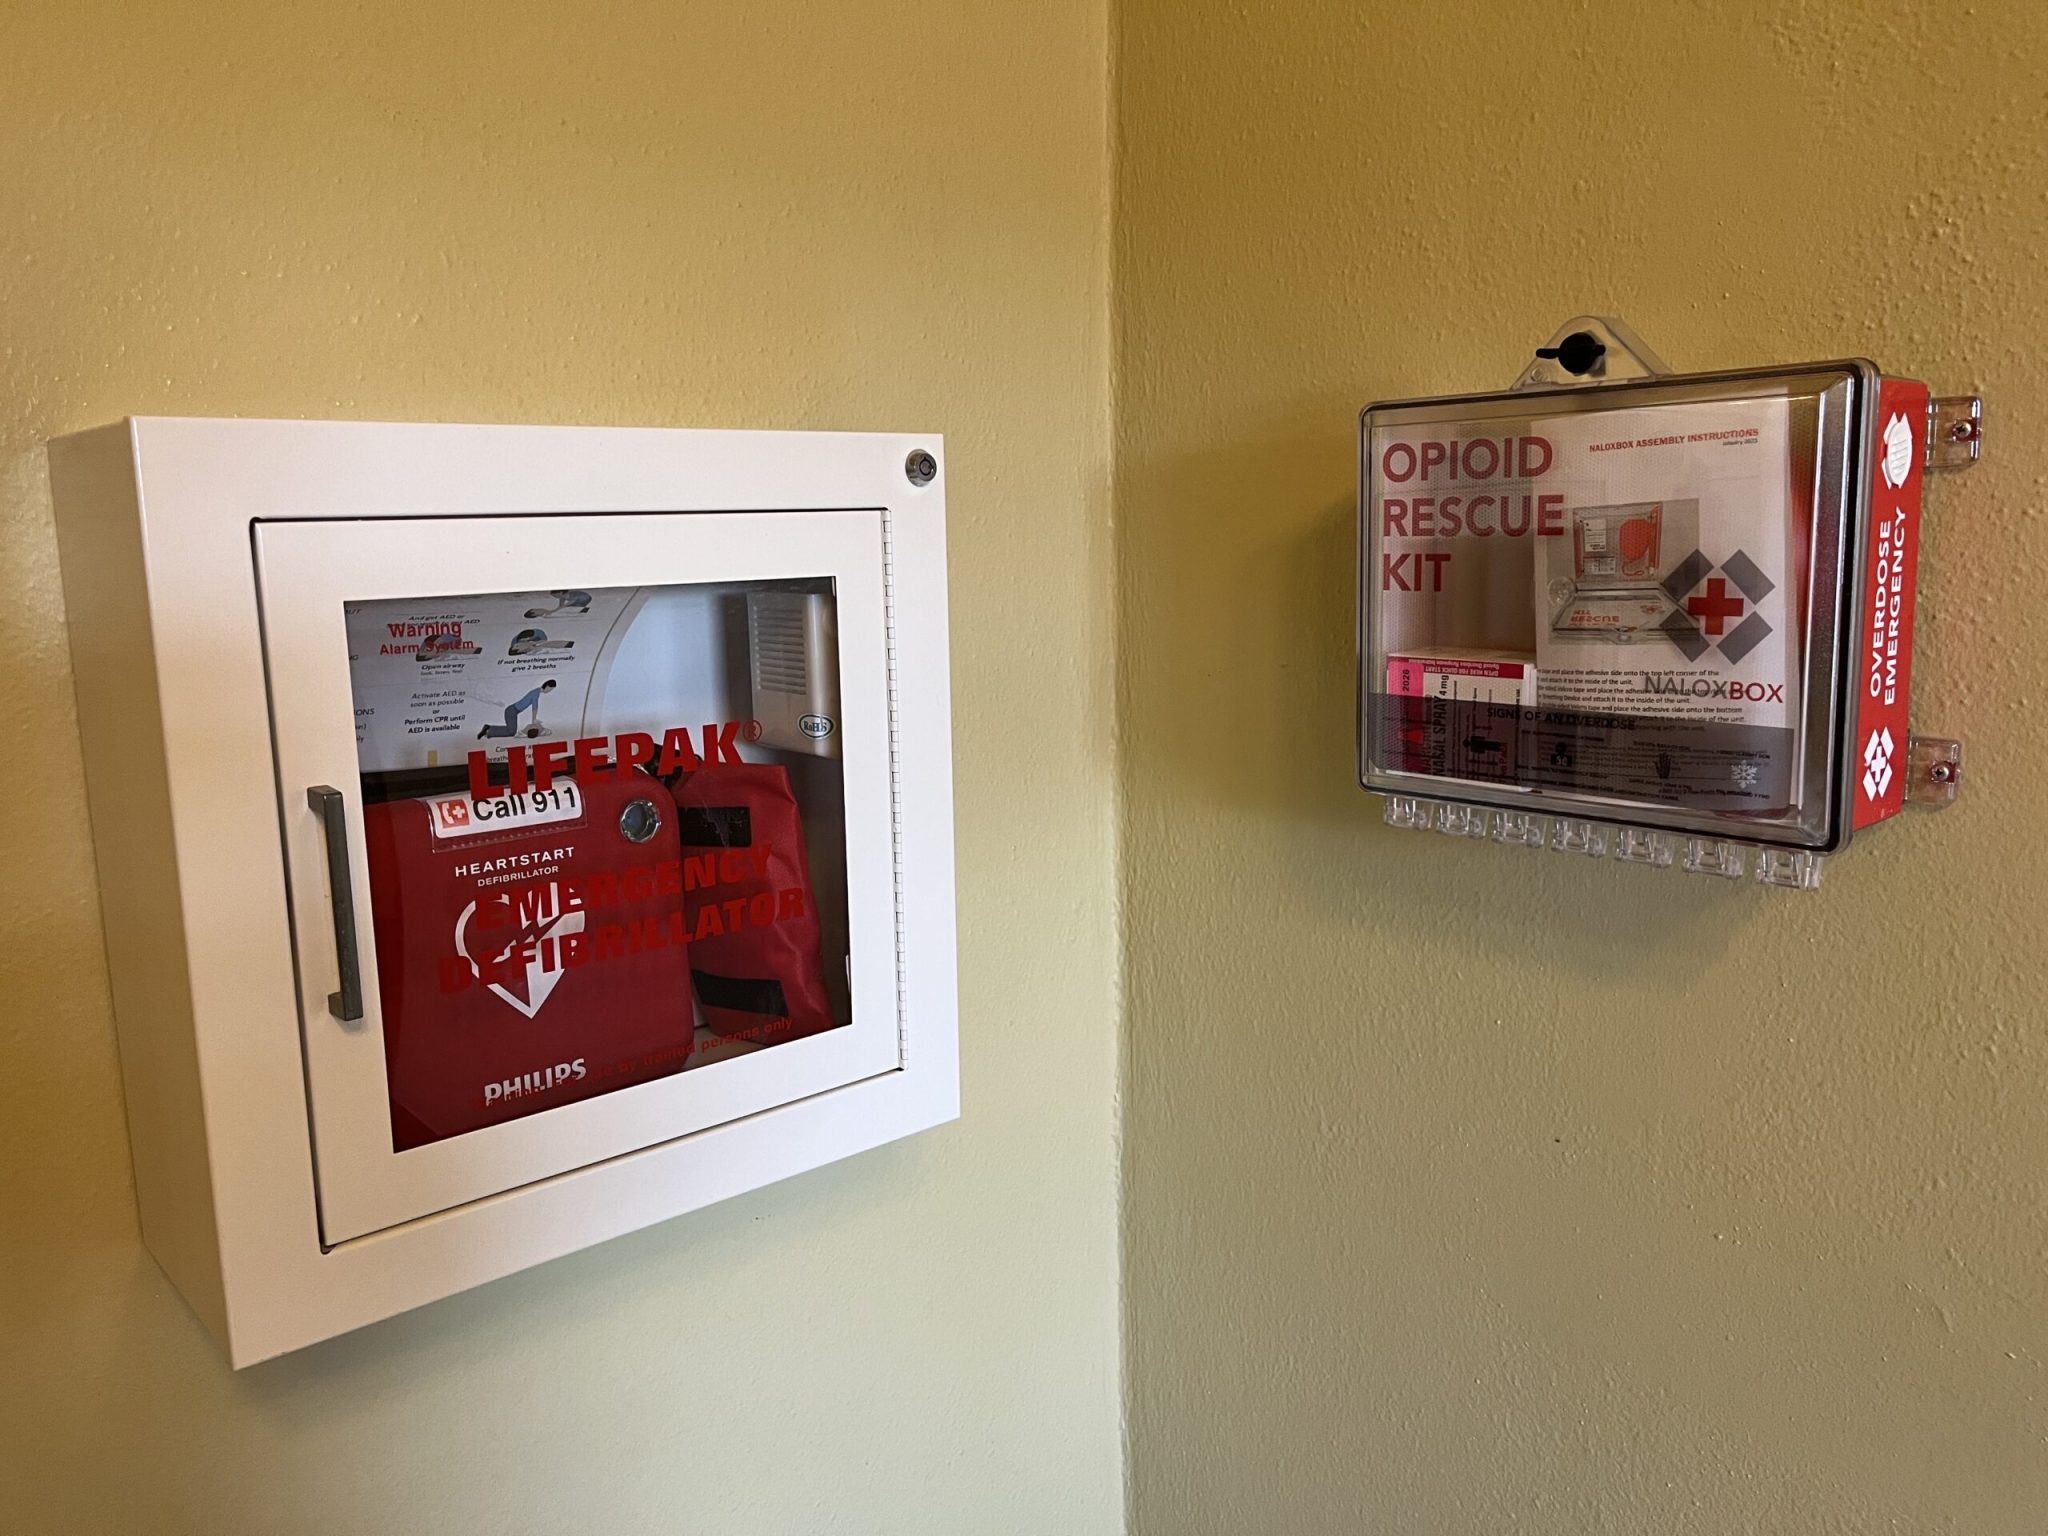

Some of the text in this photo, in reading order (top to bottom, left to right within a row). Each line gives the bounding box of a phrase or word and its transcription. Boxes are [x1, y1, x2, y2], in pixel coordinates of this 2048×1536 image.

[1382, 435, 1553, 483] OPIOID
[1589, 428, 1759, 452] NALOXBOX ASSEMBLY INSTRUCTIONS
[1382, 494, 1564, 537] RESCUE
[1382, 553, 1451, 592] KIT
[1870, 519, 1892, 697] OVERDOSE
[1884, 506, 1907, 706] EMERGENCY
[379, 640, 474, 656] Alarm System
[386, 620, 462, 638] Warning
[1644, 675, 1784, 703] NALOXBOX
[1432, 696, 1448, 735] SPRAY
[1487, 707, 1521, 720] SIGNS
[1524, 710, 1541, 720] OF
[1544, 712, 1562, 725] AN
[1566, 714, 1636, 730] OVERDOSE
[472, 786, 576, 821] Call 911
[455, 846, 575, 878] HEARTSTART
[477, 865, 559, 887] DEFIBRILLATOR
[474, 842, 773, 931] EMERGENCY
[438, 887, 805, 996] DEFIBRILLATOR
[642, 1041, 696, 1064] trained
[700, 1027, 760, 1053] persons
[763, 1017, 793, 1033] only
[484, 1057, 587, 1107] PHILIPS
